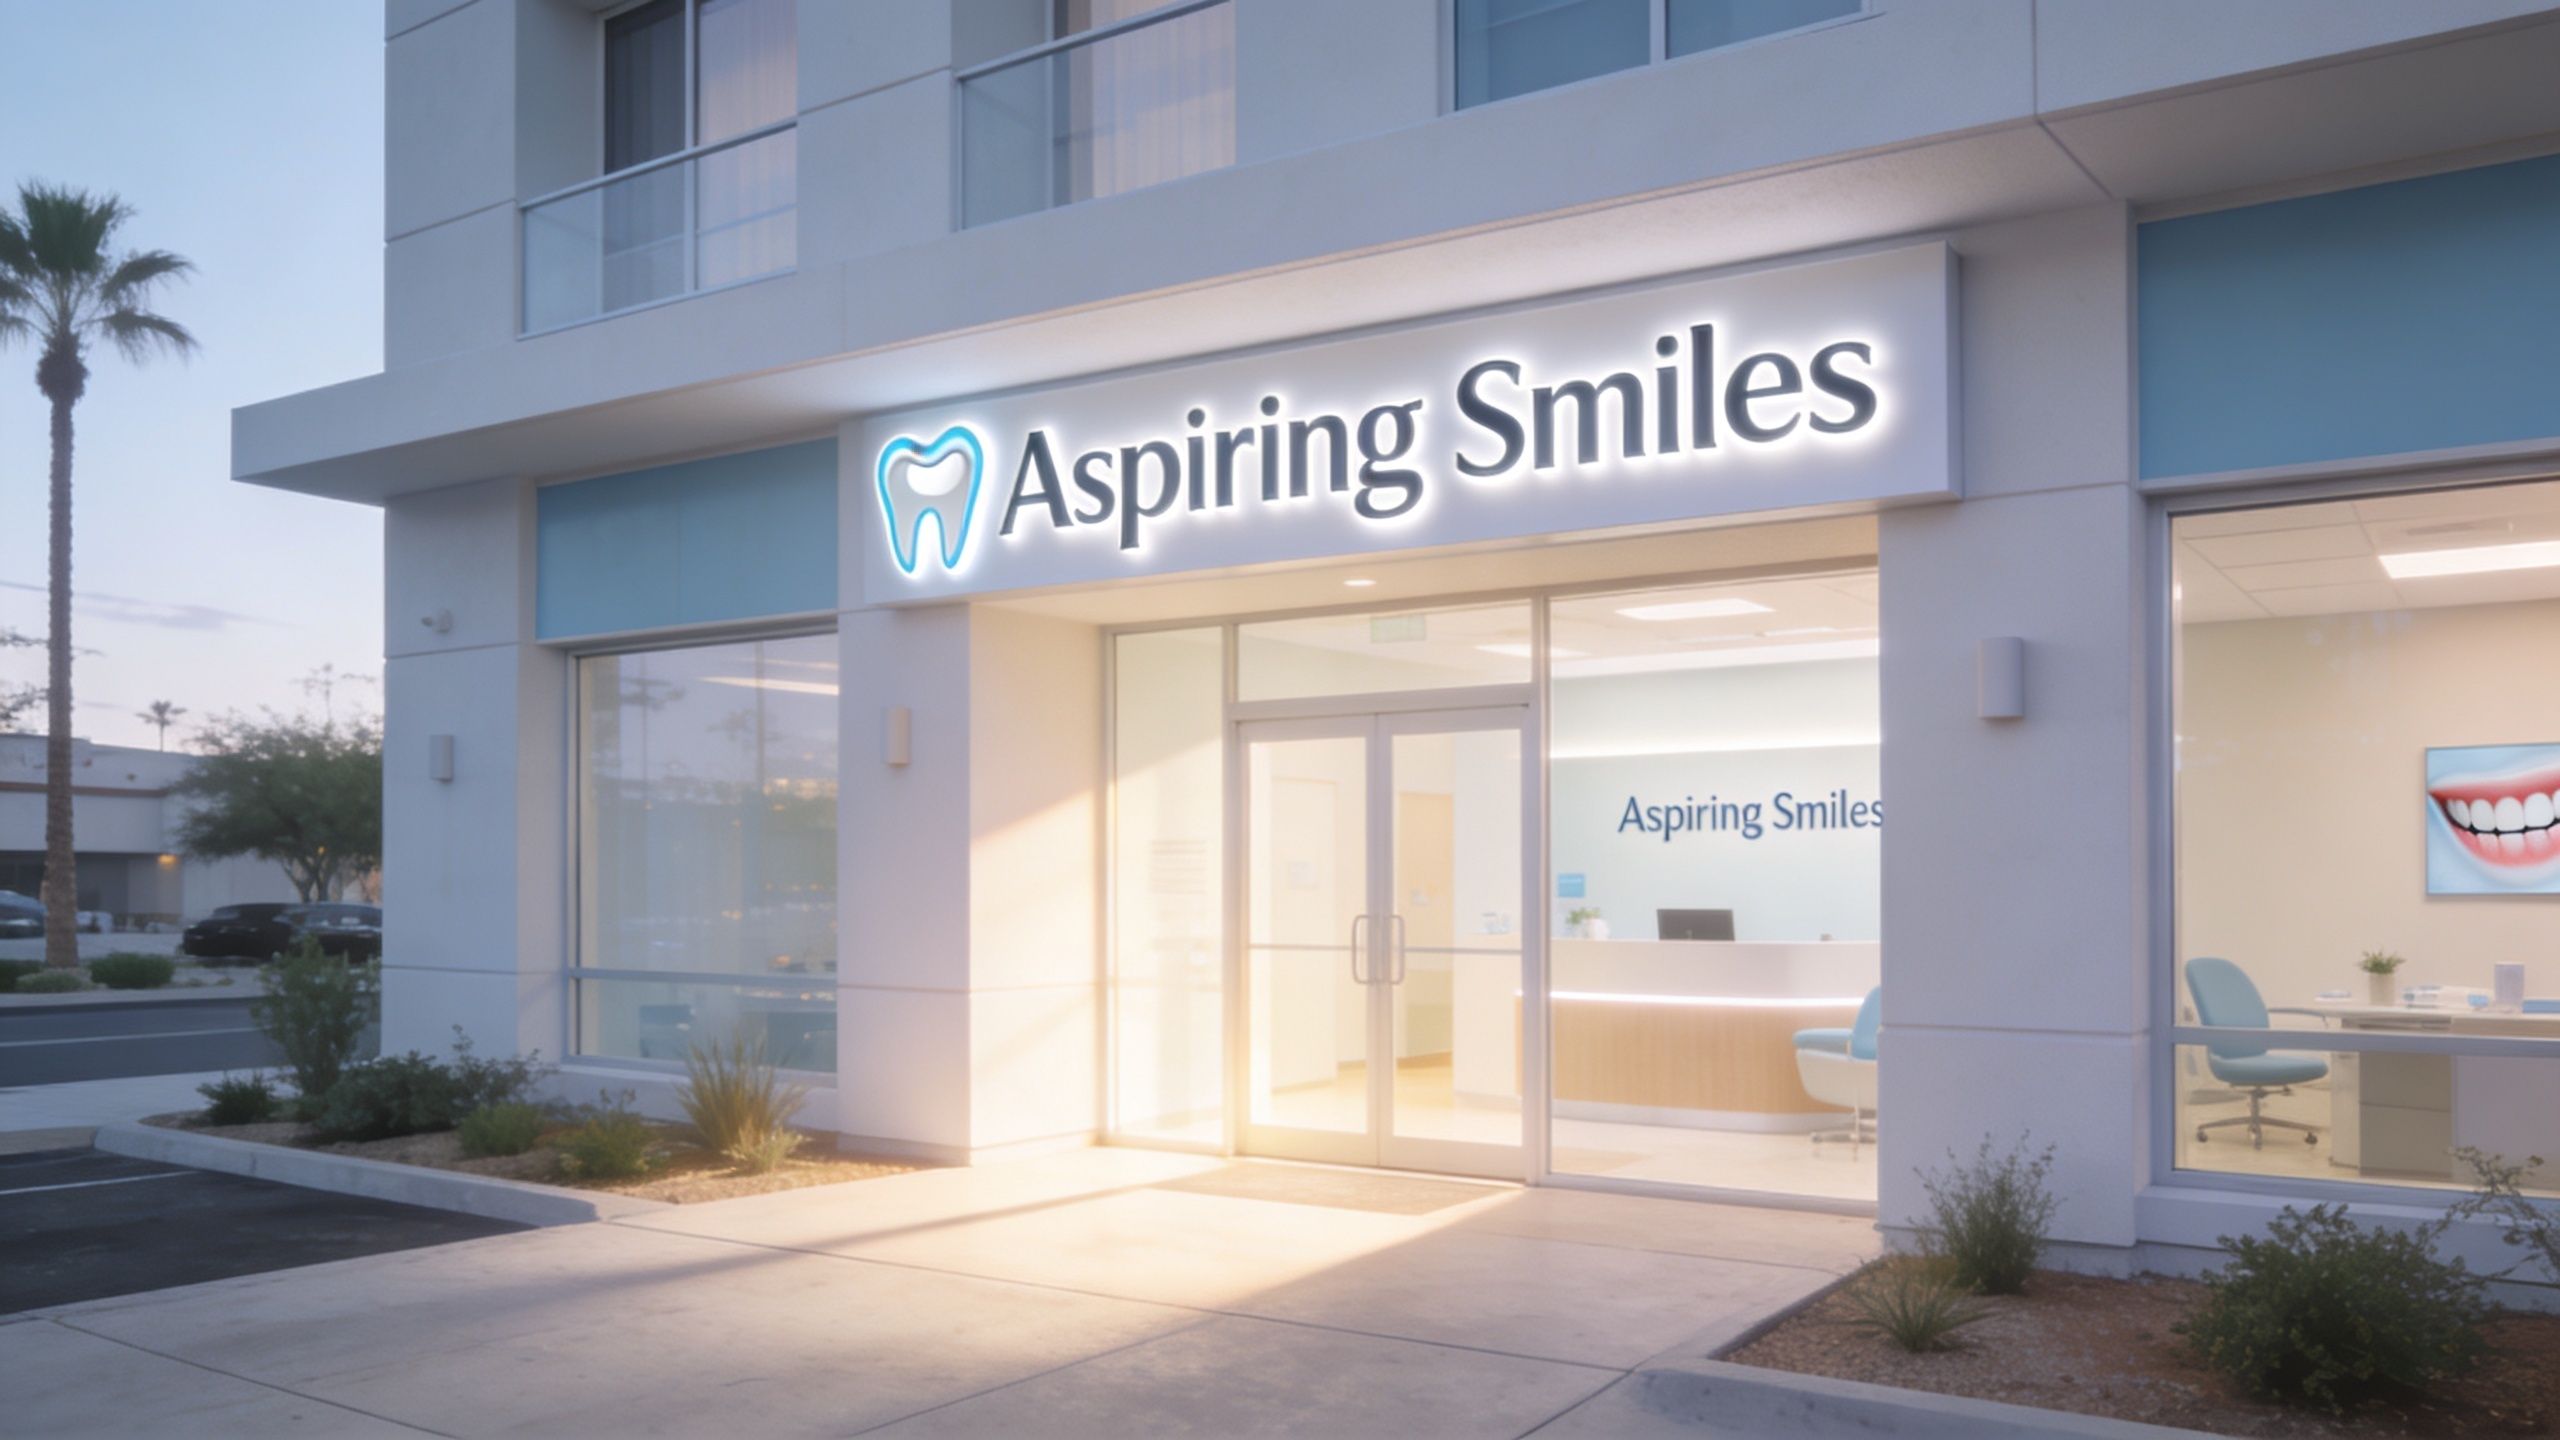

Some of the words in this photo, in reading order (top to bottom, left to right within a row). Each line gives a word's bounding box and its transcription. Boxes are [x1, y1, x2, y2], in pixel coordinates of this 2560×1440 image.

[1000, 396, 1424, 550] Aspiring
[1456, 323, 1878, 477] Smiles
[1618, 795, 1764, 842] Aspiring
[1772, 789, 1884, 831] Smiles
